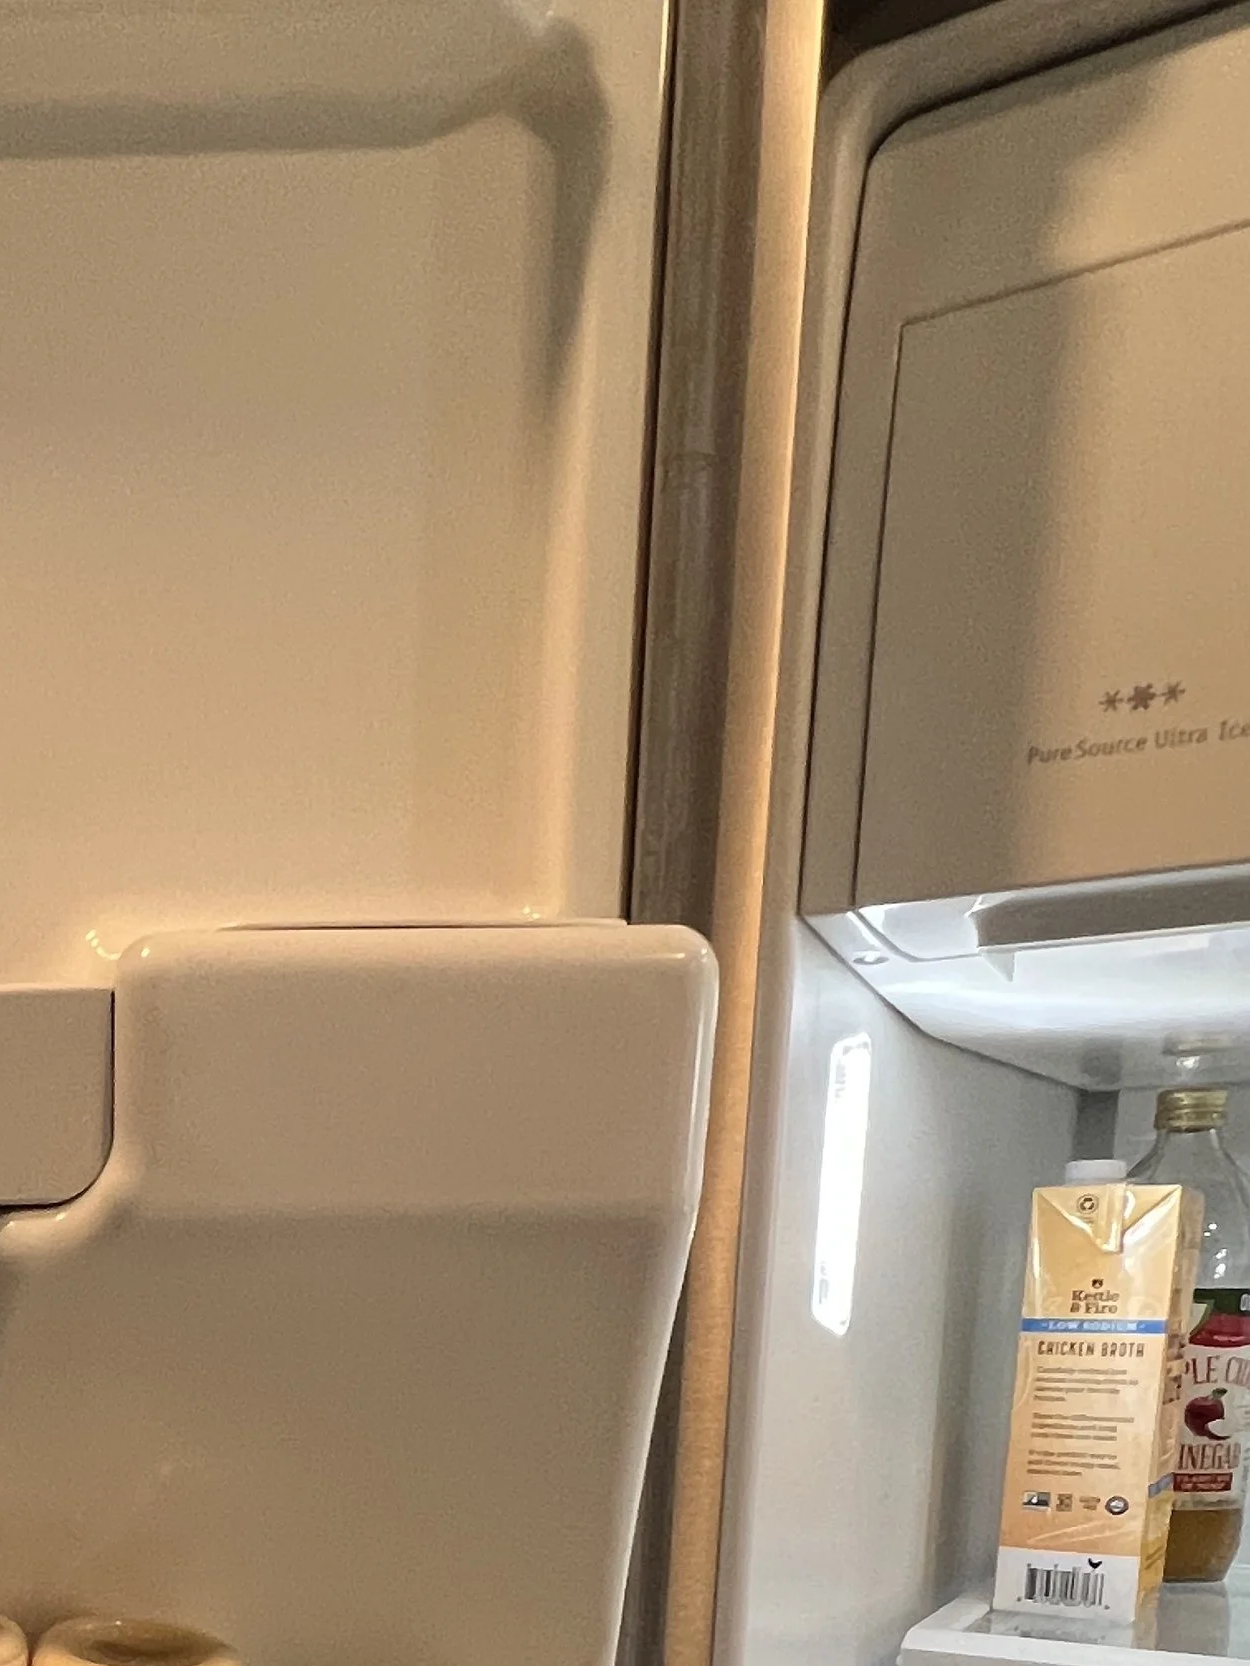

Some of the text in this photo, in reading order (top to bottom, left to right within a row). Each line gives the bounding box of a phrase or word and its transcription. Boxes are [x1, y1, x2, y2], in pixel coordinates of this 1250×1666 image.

[1154, 727, 1209, 749] Ultra
[1037, 1340, 1145, 1358] CHICKEN BROTH
